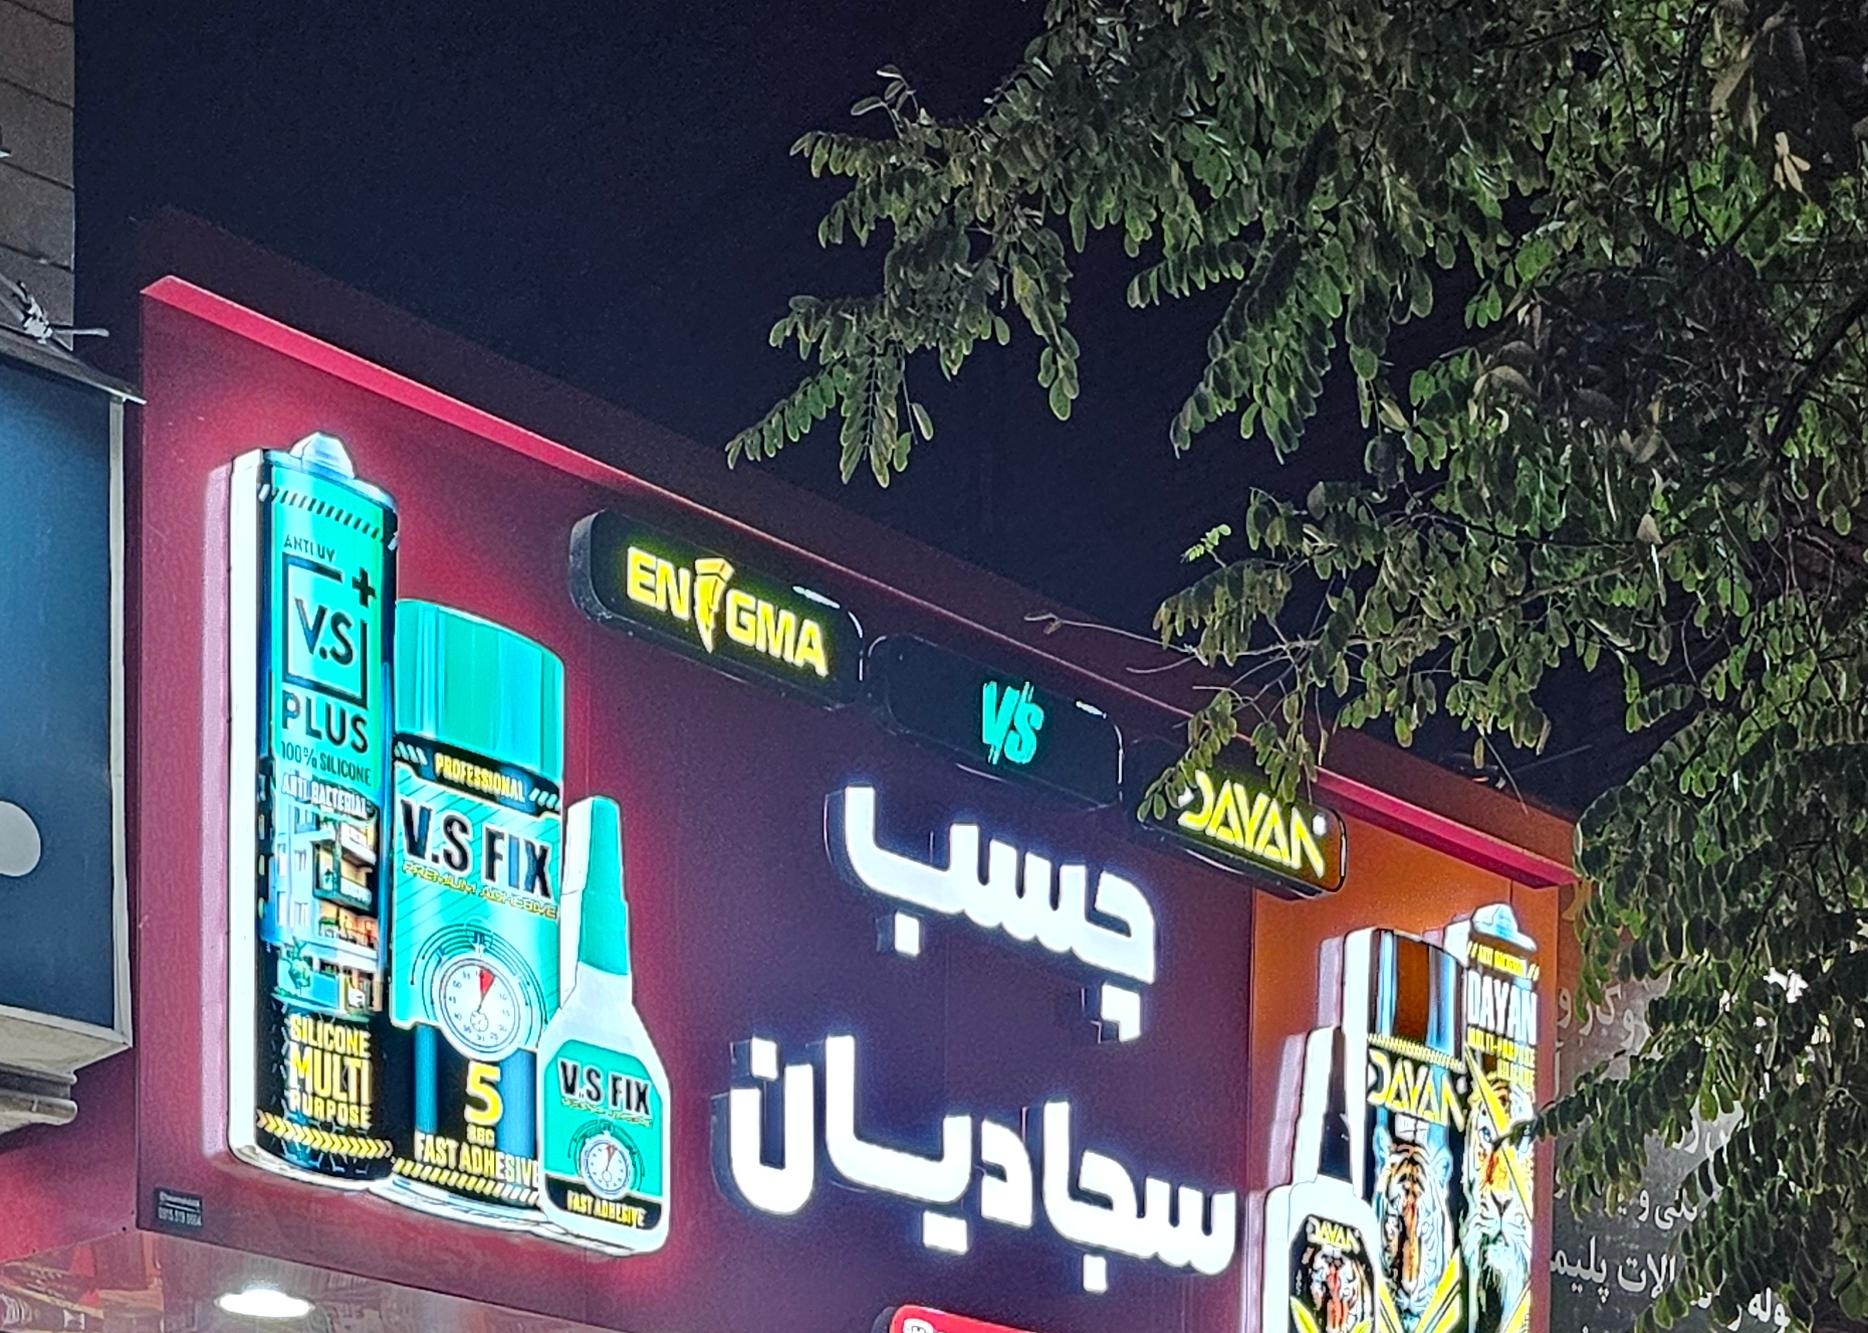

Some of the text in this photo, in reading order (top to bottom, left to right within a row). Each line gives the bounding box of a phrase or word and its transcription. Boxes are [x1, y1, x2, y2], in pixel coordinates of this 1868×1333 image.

[284, 534, 336, 563] ANTI UV
[294, 597, 353, 664] V.S
[282, 691, 368, 754] PLUS
[983, 681, 1044, 766] VS
[320, 753, 372, 787] SILICONE
[434, 752, 526, 803] PROFESSIONAL
[401, 798, 552, 899] V.S FIX
[844, 786, 1156, 1042] چسب
[289, 1013, 372, 1059] SILICONE
[1467, 969, 1538, 1046] DAYAN
[288, 1041, 371, 1107] MULTI
[464, 1060, 503, 1125] 5
[611, 1073, 650, 1116] FIX
[1367, 1048, 1466, 1133] DAYAN
[289, 1088, 372, 1130] PURPOSE
[414, 1131, 459, 1170] FAST
[729, 1034, 1236, 1293] سجادیان
[567, 1190, 648, 1228] FAST ADHESIVE
